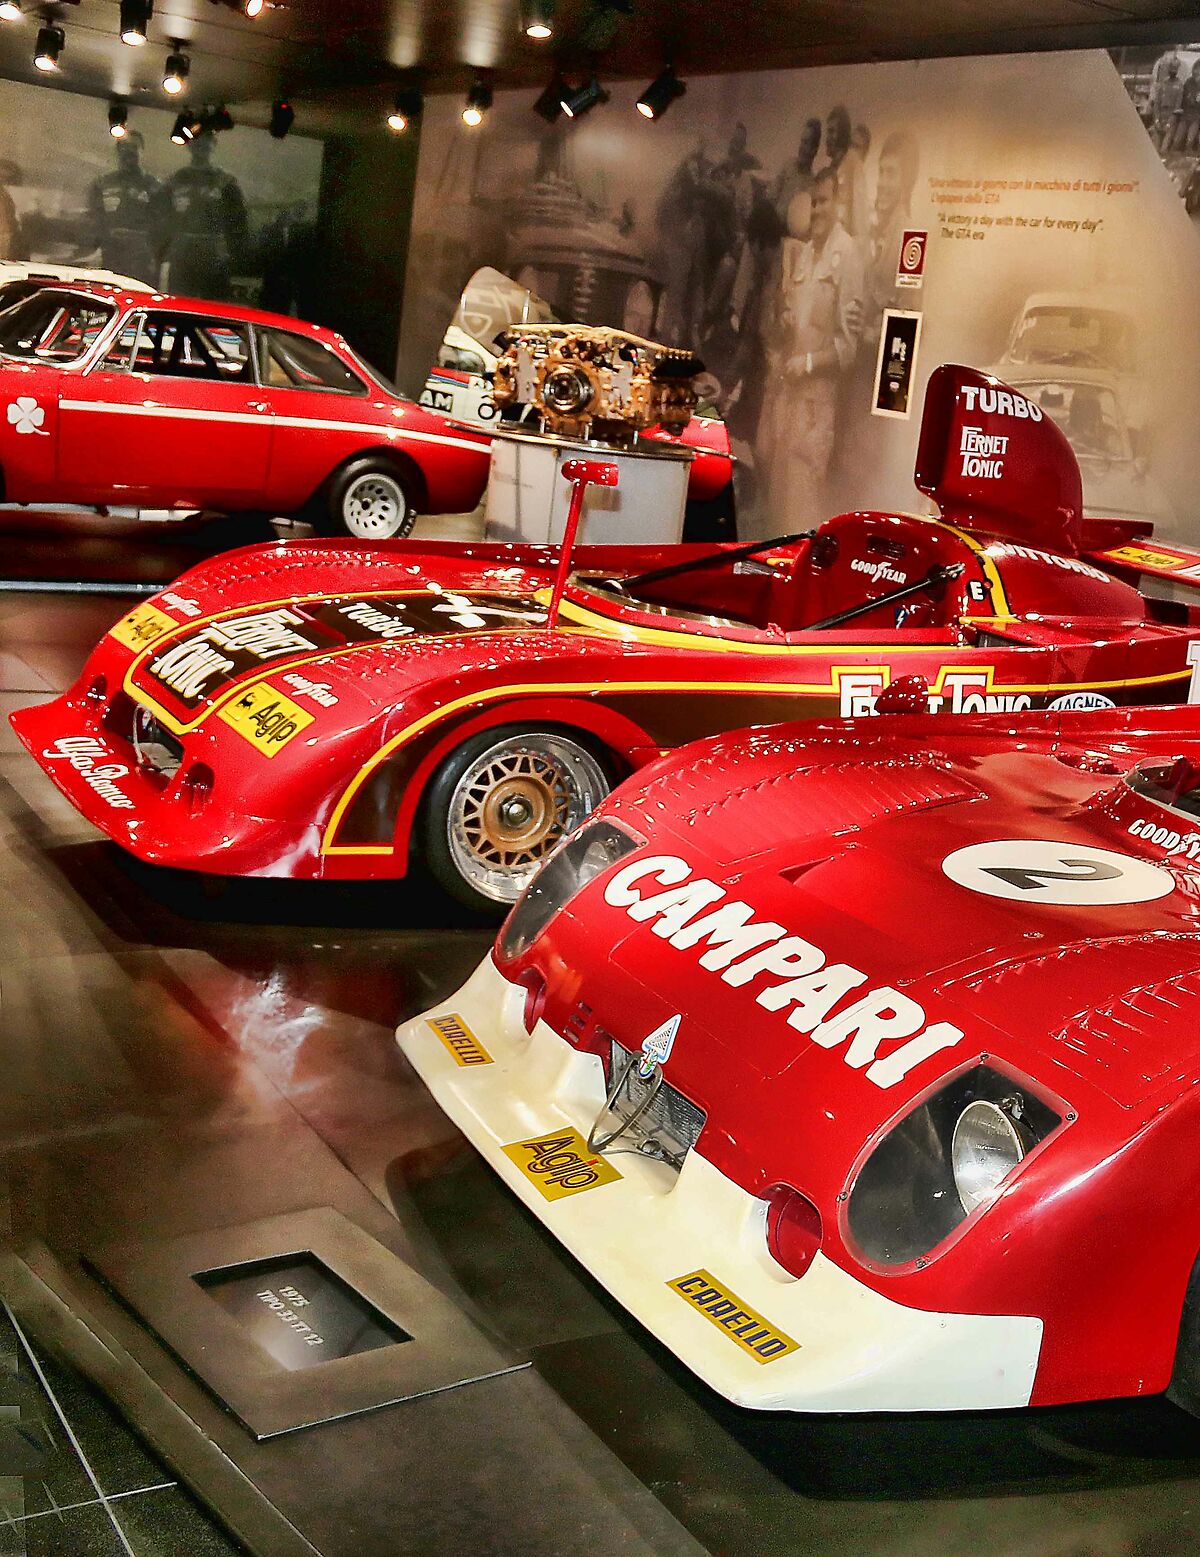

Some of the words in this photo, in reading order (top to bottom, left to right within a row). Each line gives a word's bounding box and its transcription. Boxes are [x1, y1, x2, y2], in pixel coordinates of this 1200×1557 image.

[1015, 216, 1028, 227] the
[1029, 218, 1041, 227] car
[1043, 216, 1055, 228] for
[1057, 219, 1079, 233] every
[961, 385, 1043, 422] TURBO
[960, 425, 1009, 458] FERNET
[960, 451, 1004, 479] TONIC
[970, 581, 984, 600] E
[210, 608, 319, 660] FERNET
[338, 602, 415, 638] TURBO
[149, 627, 235, 699] TONIC
[249, 700, 298, 745] Agip
[978, 858, 1125, 891] 2
[603, 854, 966, 1090] CAMPARI
[434, 1016, 486, 1065] CARELLO
[522, 1134, 600, 1190] Agip
[677, 1275, 789, 1358] CARELLO
